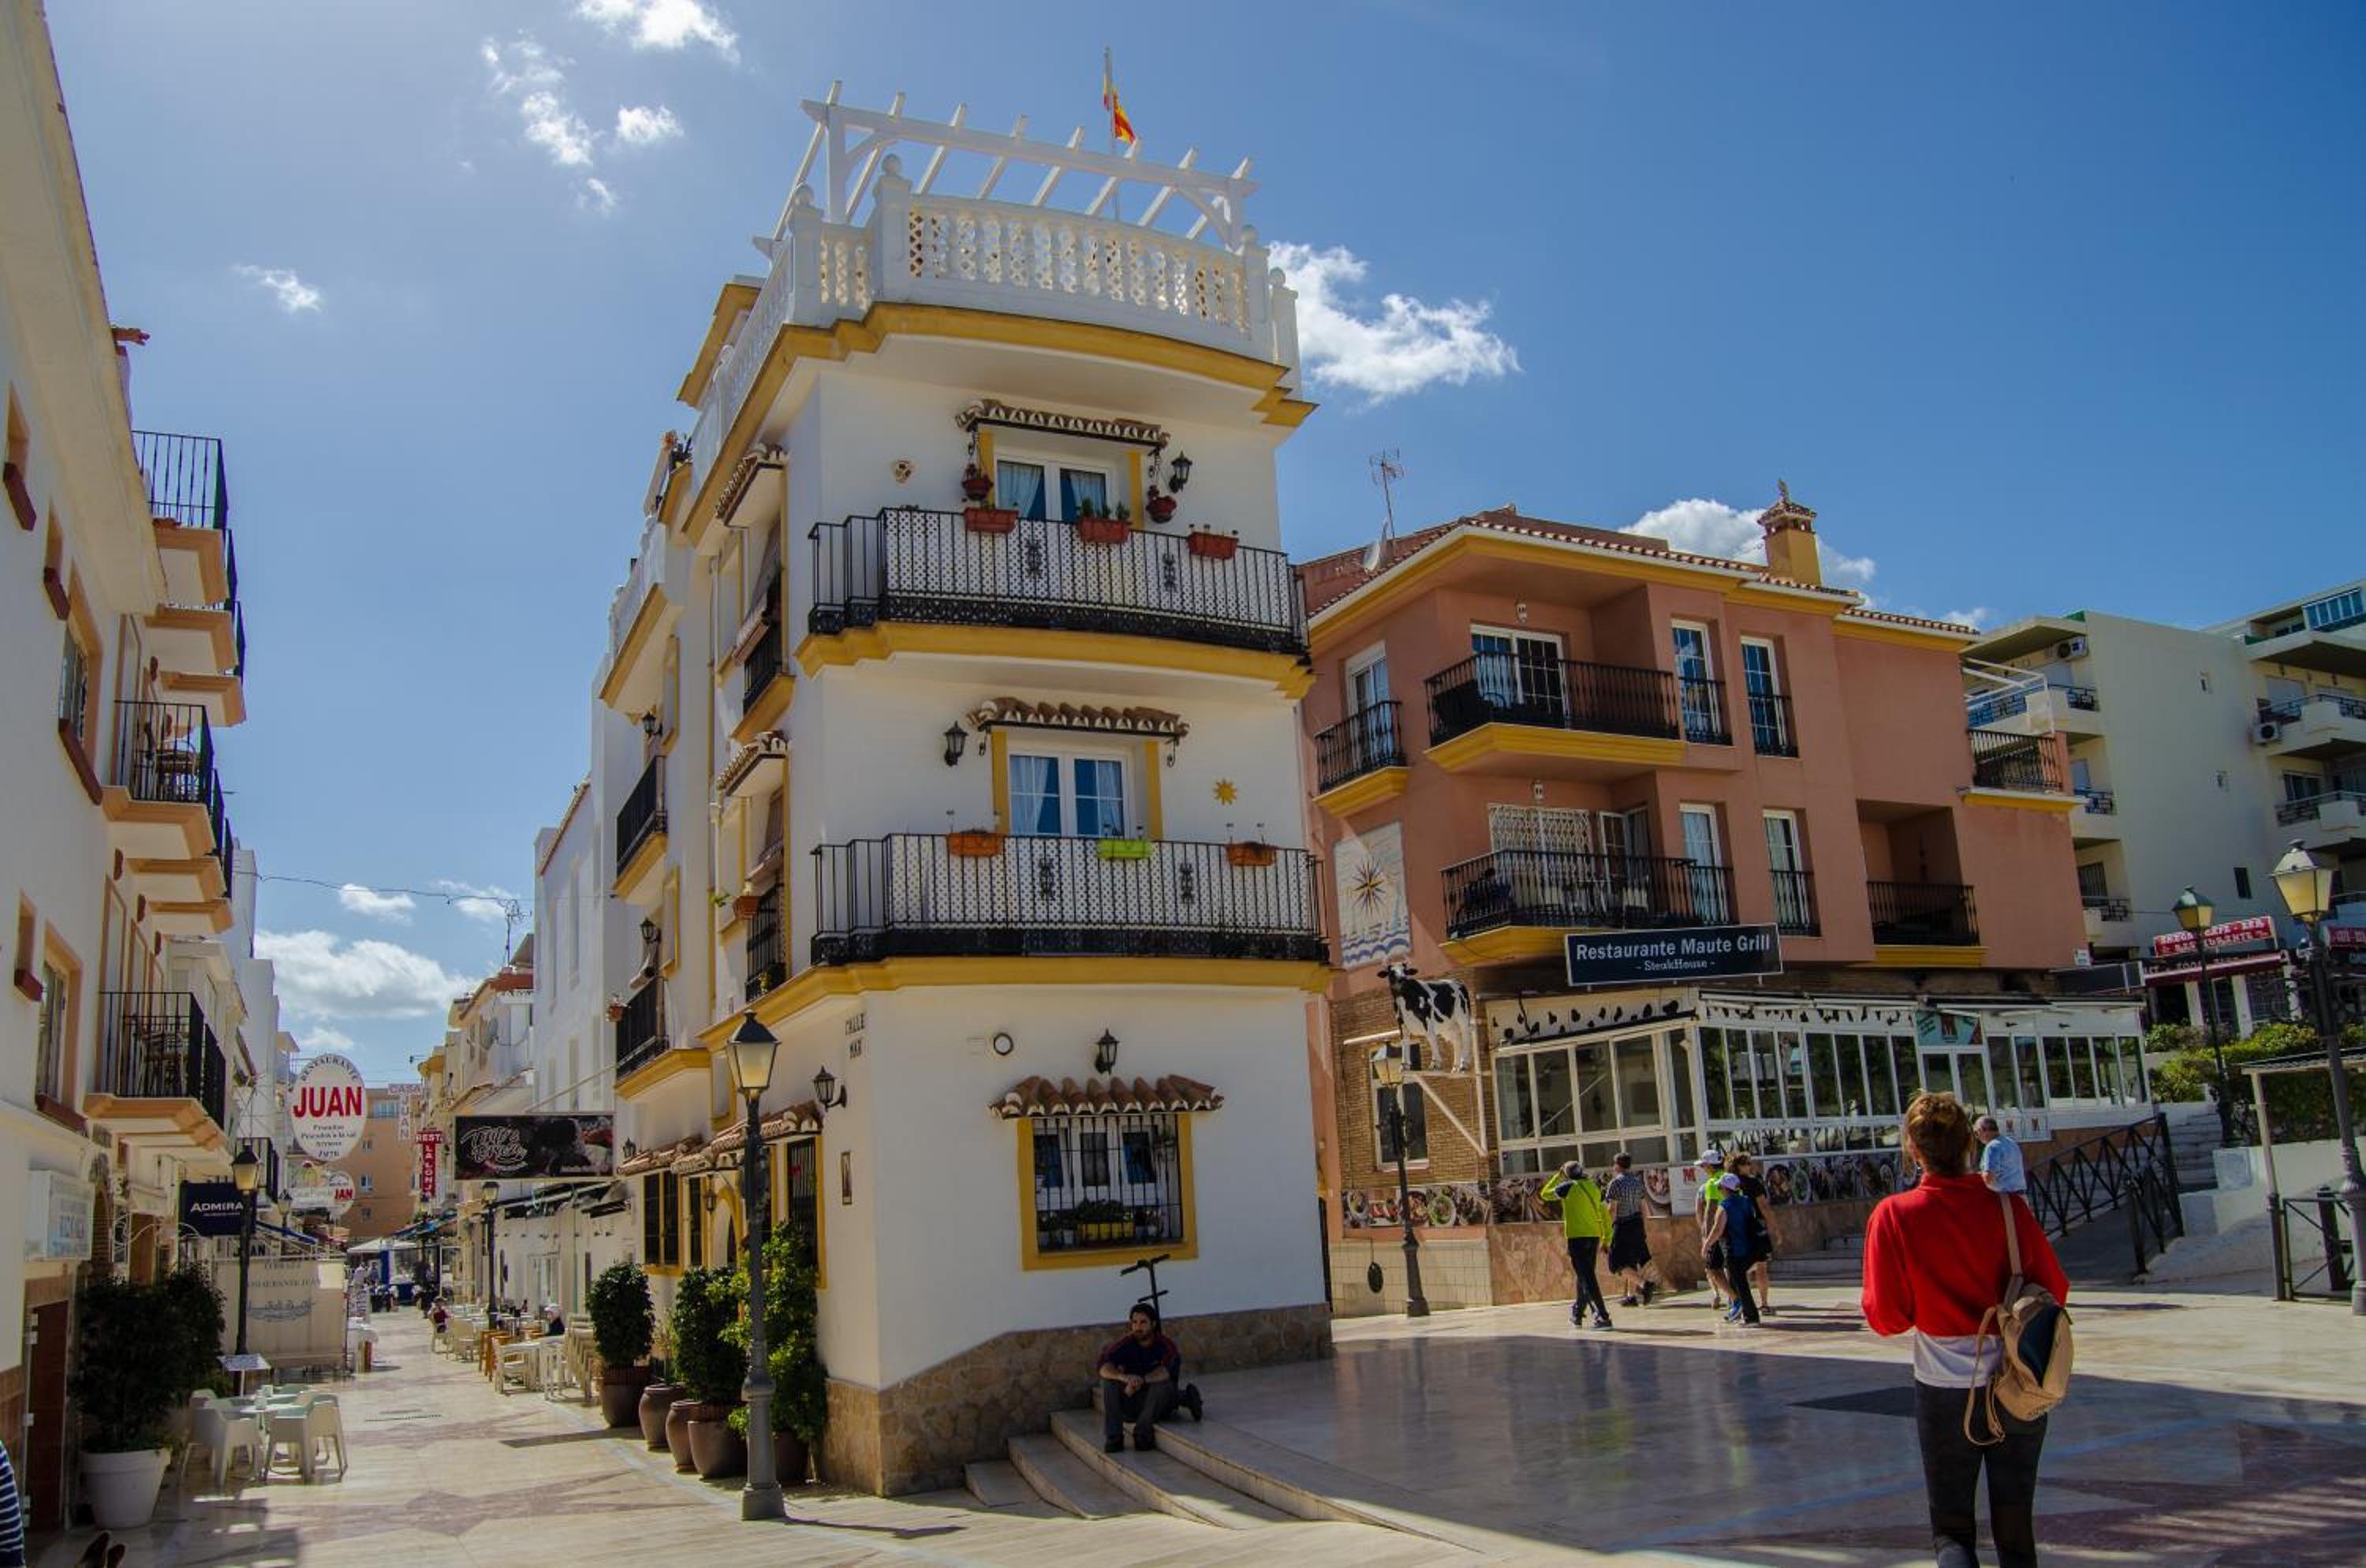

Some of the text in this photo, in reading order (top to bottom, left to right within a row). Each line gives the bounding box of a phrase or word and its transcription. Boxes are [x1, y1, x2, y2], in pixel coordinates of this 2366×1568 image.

[1577, 934, 1770, 960] Restaurante Maute Grill
[1644, 960, 1707, 971] SteakHouse
[845, 1014, 864, 1035] CALLE
[850, 1040, 861, 1058] MAR
[293, 1086, 362, 1118] JUAN
[190, 1202, 244, 1211] ADMIRA
